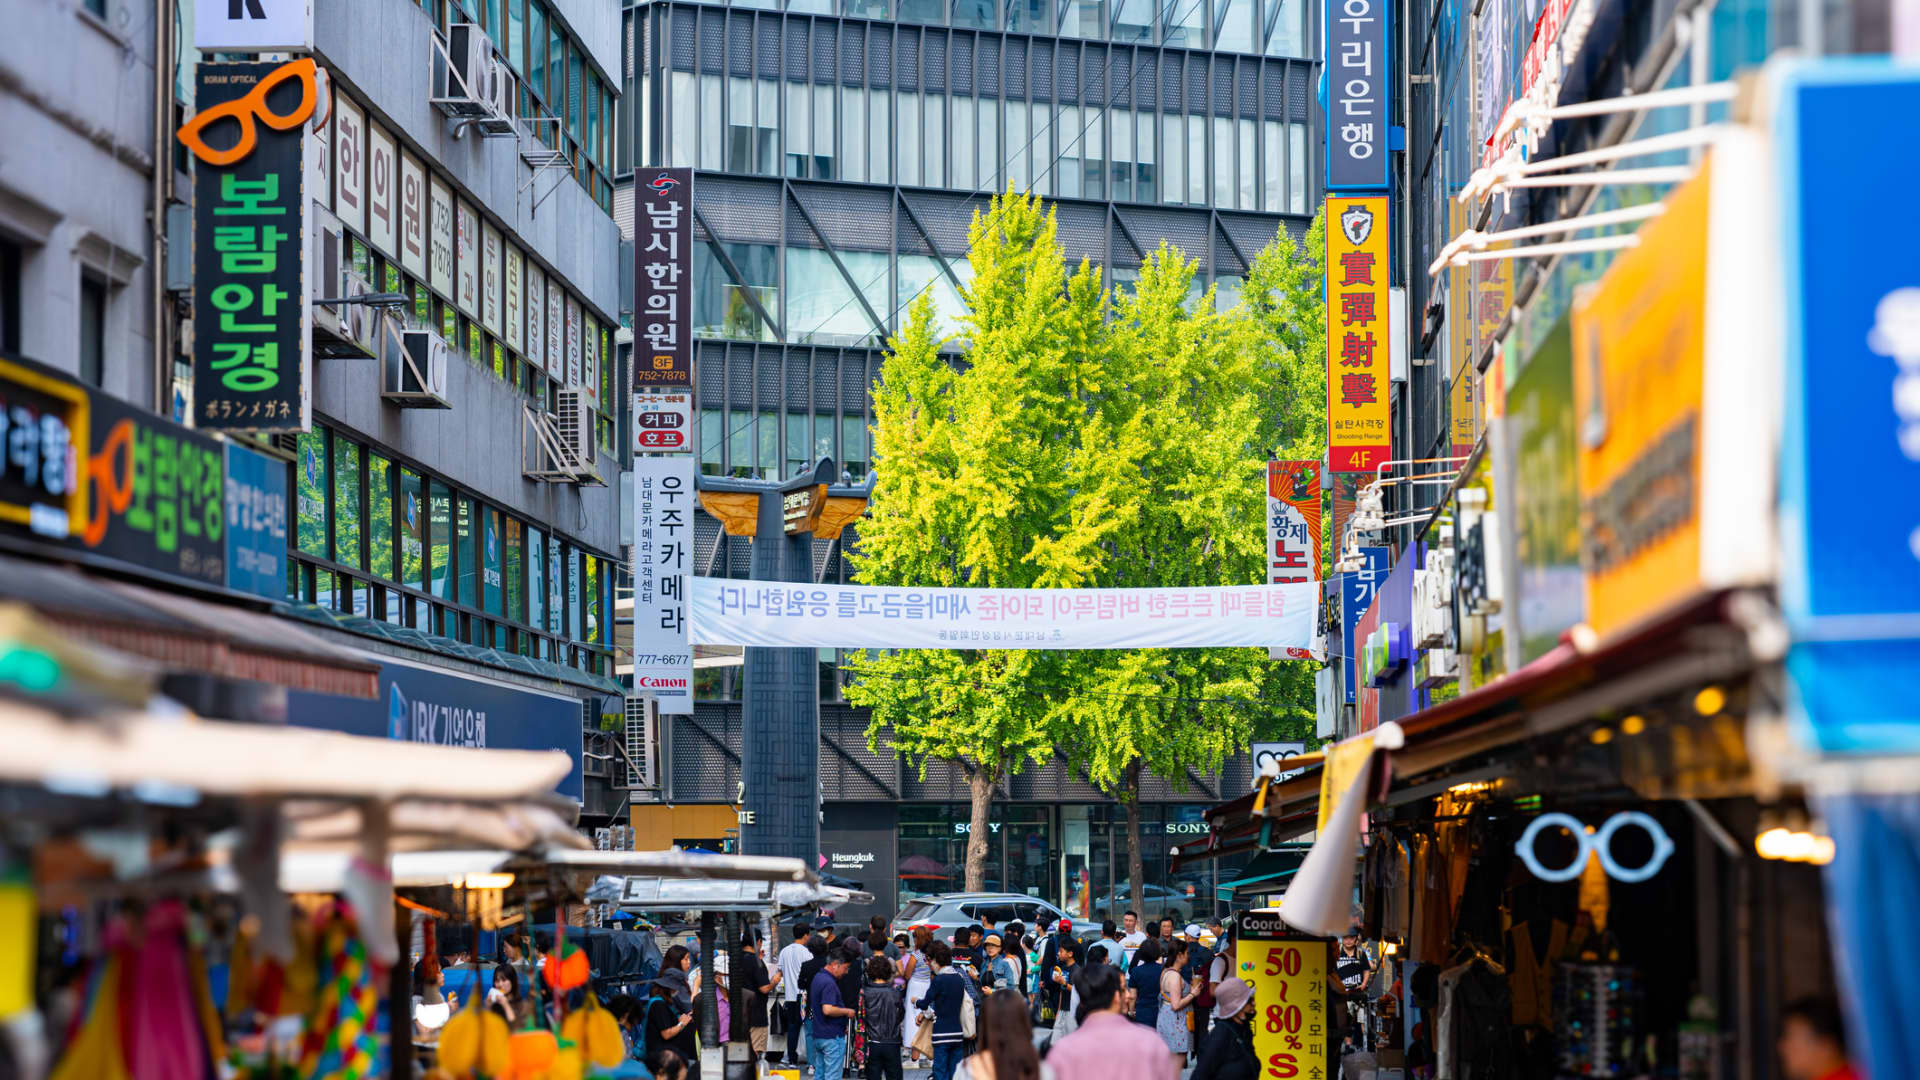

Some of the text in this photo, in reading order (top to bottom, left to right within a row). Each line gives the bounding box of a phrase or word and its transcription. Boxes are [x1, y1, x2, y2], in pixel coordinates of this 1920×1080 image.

[204, 75, 257, 84] BORAM OPTICAL
[1339, 0, 1374, 160] 우리은행
[210, 173, 288, 392] 보람안경
[643, 200, 683, 351] 남시한의원
[1339, 250, 1377, 409] 實彈射擊
[655, 358, 673, 368] 3F
[638, 371, 686, 381] 752-7878
[205, 400, 291, 419] ボランメガネ
[645, 413, 677, 427] 커피
[1334, 419, 1385, 430] 실탄사격장
[644, 432, 678, 445] 호프
[1336, 433, 1383, 441] Shooting Range
[1349, 451, 1371, 469] 4F
[125, 425, 223, 551] 보람안경
[1271, 515, 1307, 545] 황제
[660, 476, 684, 634] 우주카메라
[638, 654, 689, 665] 777-6677
[640, 676, 687, 688] Canon
[737, 780, 745, 804] 2
[1166, 823, 1210, 833] SONY
[832, 853, 875, 863] Heungkuk
[1265, 947, 1302, 977] 50
[1265, 1004, 1302, 1034] 80
